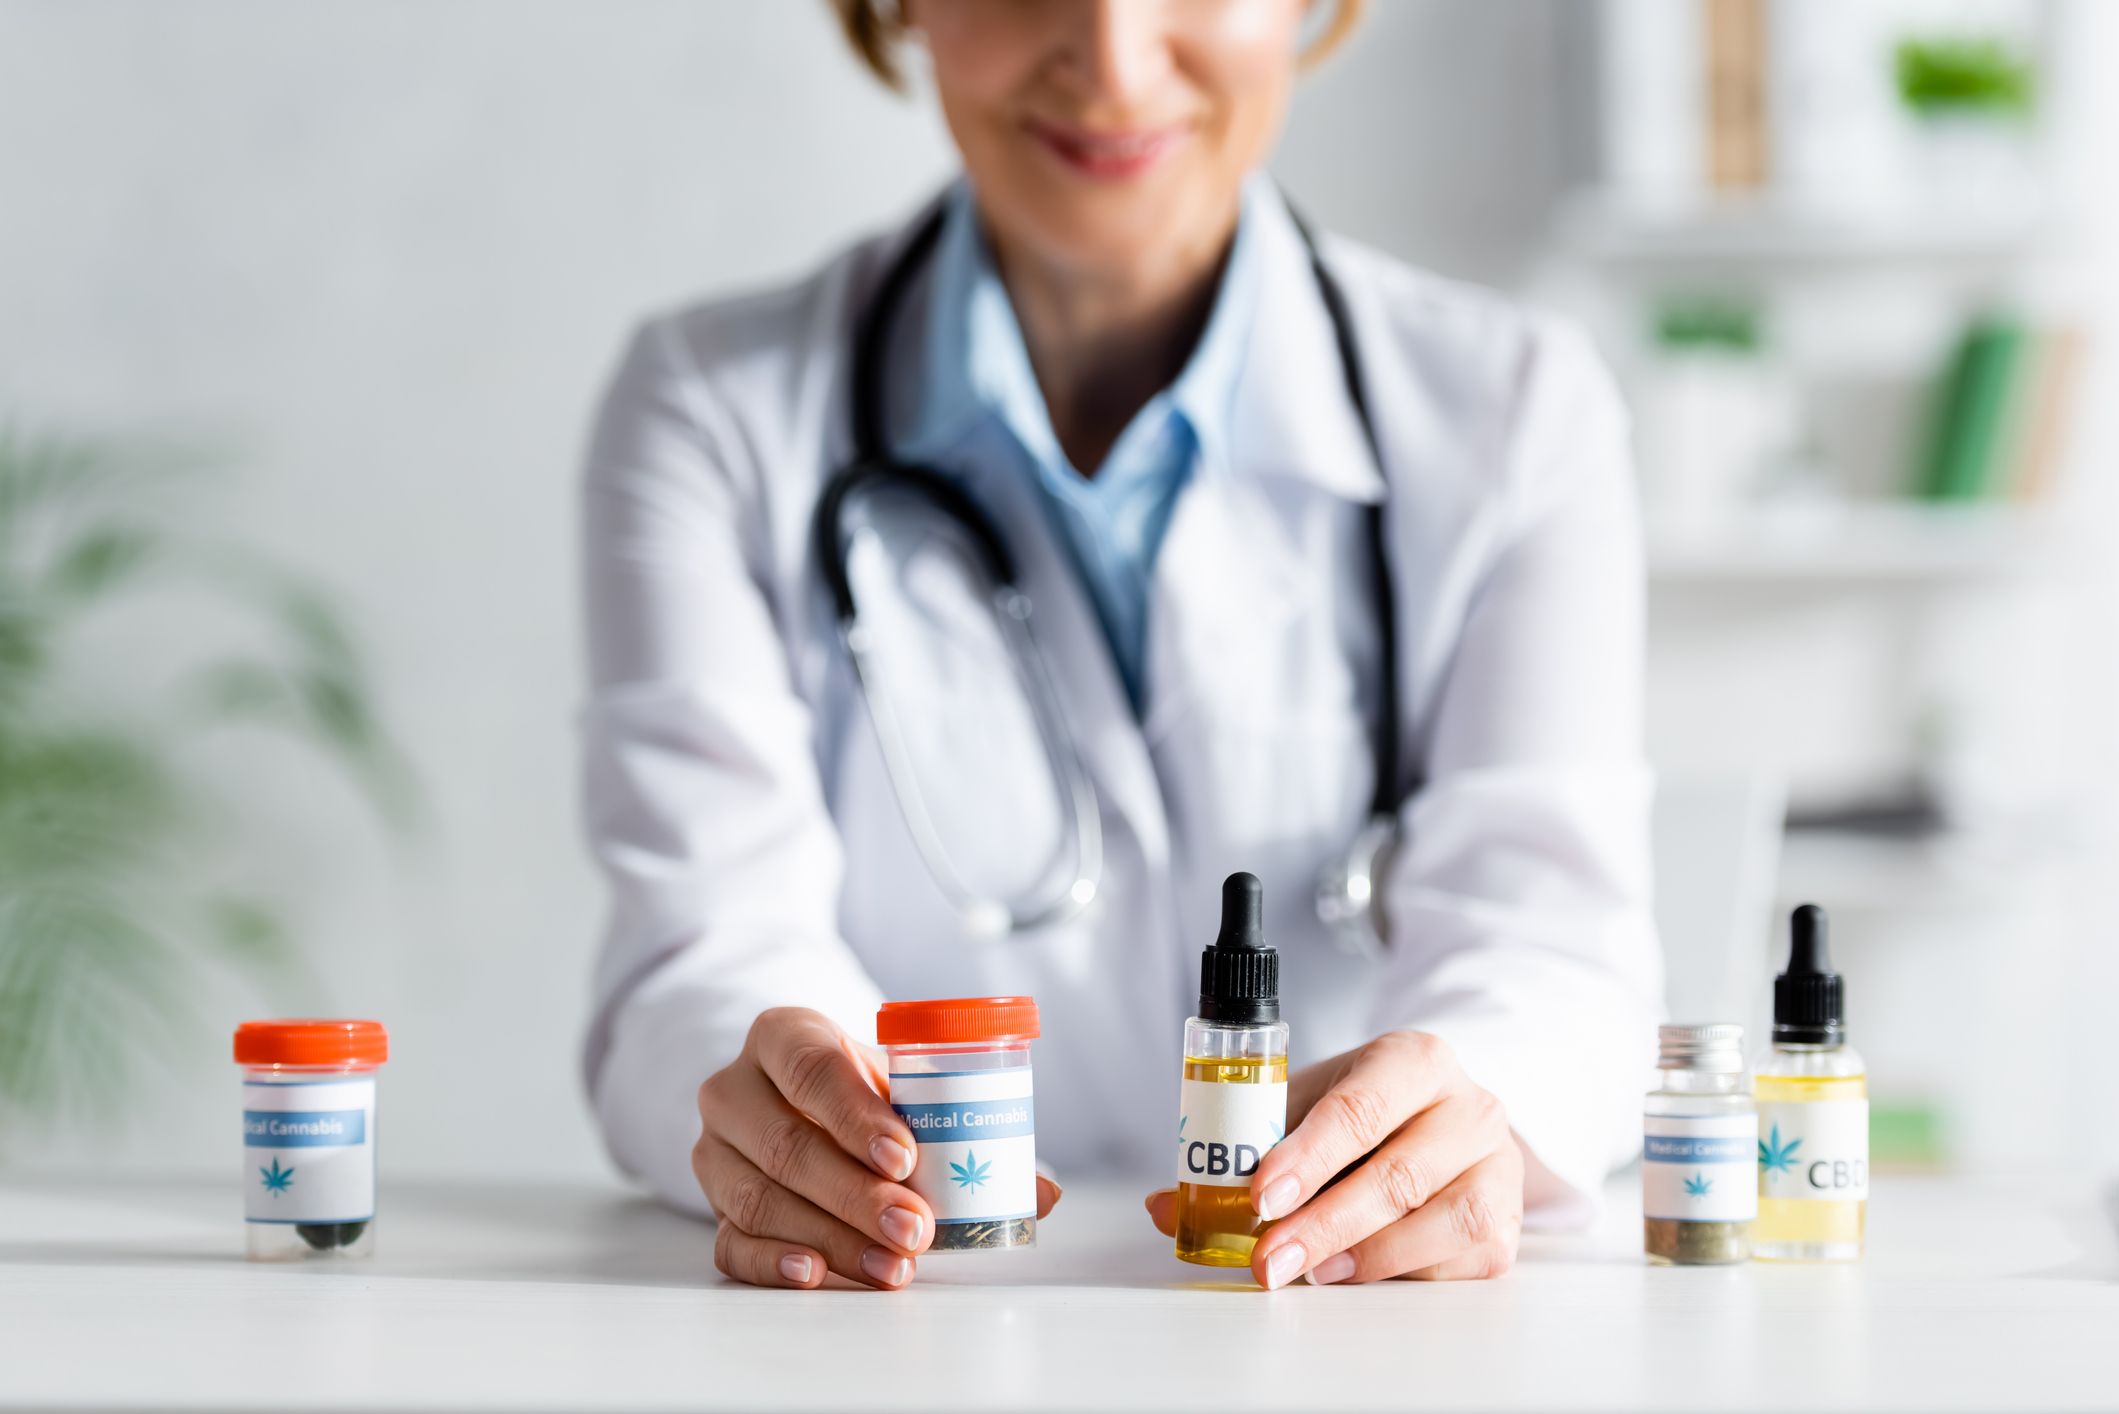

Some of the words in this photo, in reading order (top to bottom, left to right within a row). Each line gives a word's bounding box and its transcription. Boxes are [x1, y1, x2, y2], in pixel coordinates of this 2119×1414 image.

[269, 1117, 344, 1136] Cannabis
[962, 1107, 1028, 1127] Cannabis
[1187, 1140, 1260, 1177] CBD
[1649, 1141, 1693, 1156] Medical
[1808, 1160, 1867, 1189] CBD
